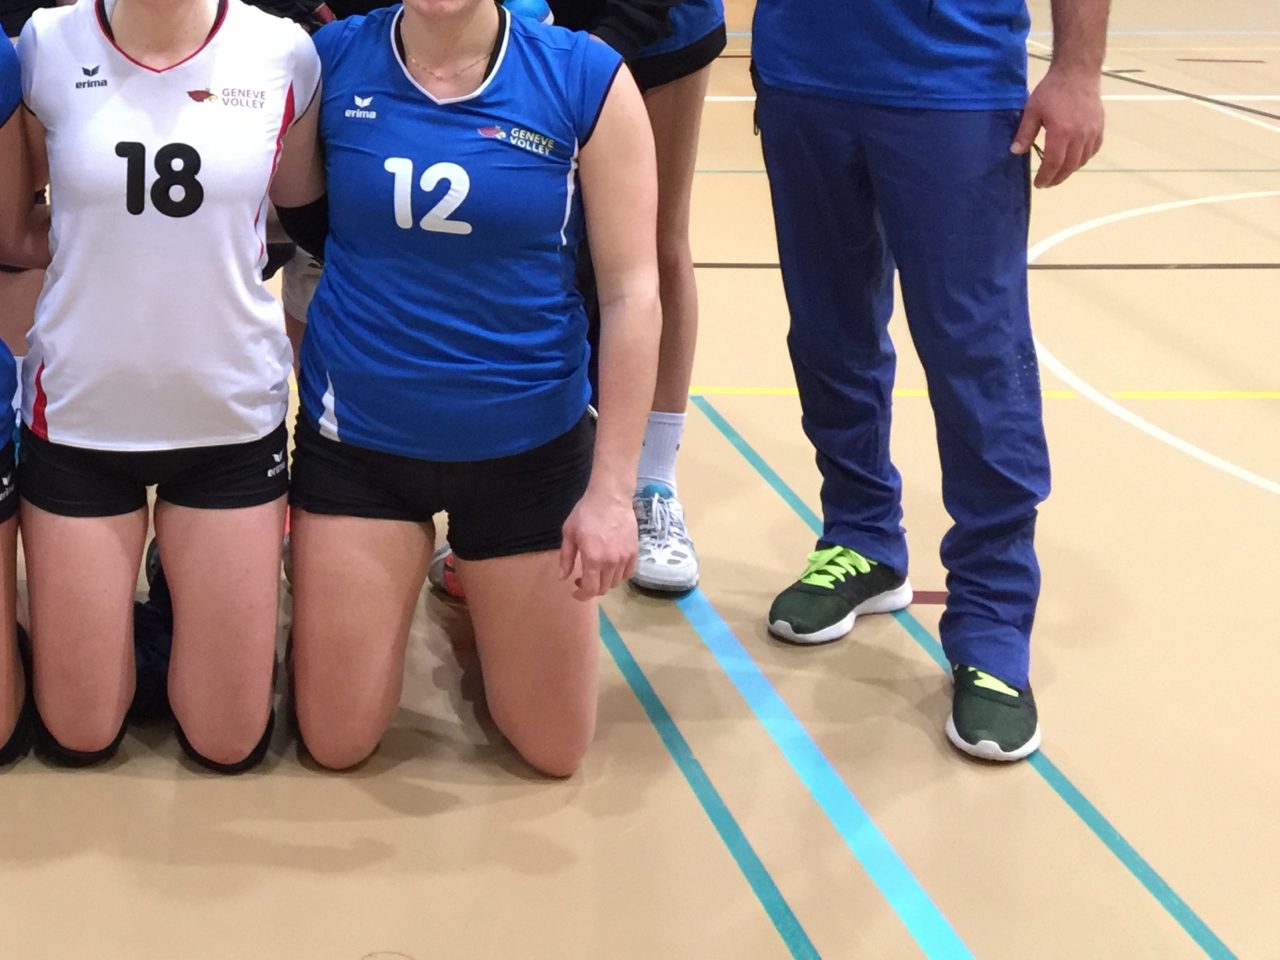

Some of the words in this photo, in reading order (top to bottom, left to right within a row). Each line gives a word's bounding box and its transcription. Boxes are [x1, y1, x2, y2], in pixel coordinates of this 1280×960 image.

[75, 78, 108, 90] erima
[222, 88, 266, 101] GENEVE
[222, 97, 265, 110] VOLLEY
[345, 109, 377, 120] erima
[509, 136, 551, 157] VOLLEY
[510, 128, 555, 150] GENEVE
[114, 141, 205, 218] 18
[384, 157, 473, 236] 12
